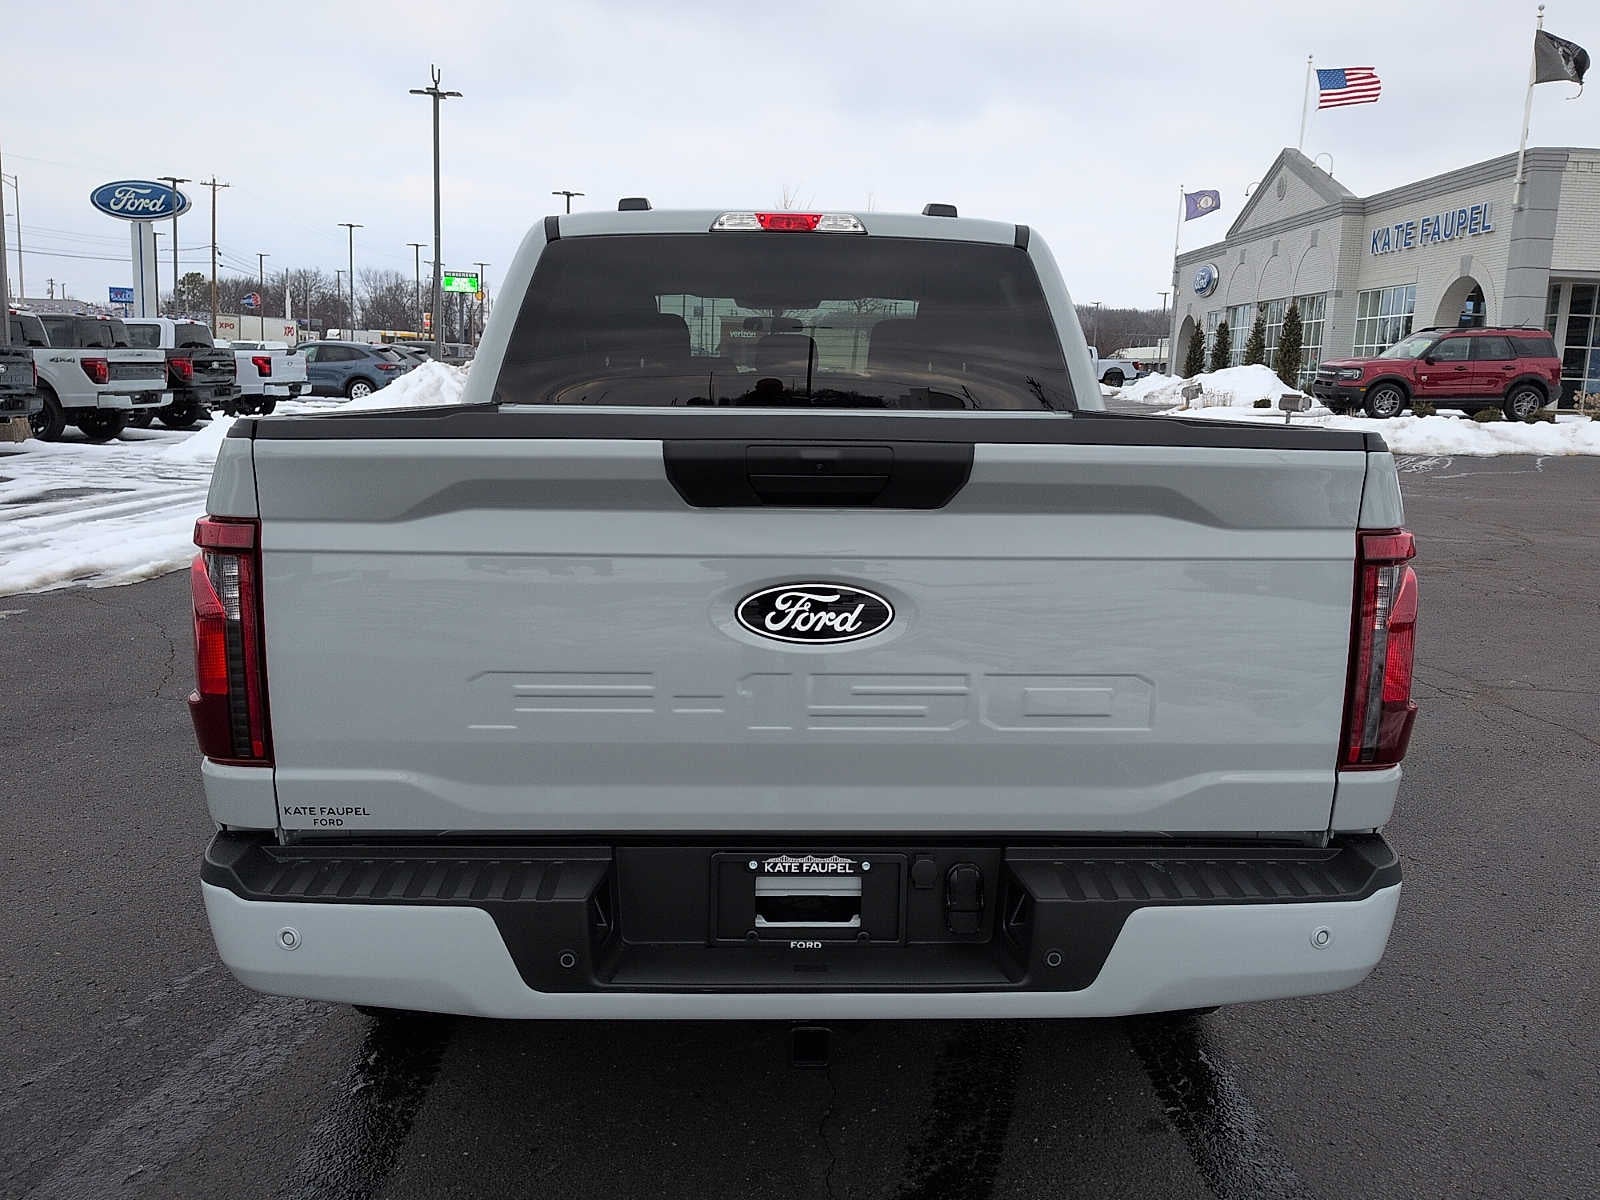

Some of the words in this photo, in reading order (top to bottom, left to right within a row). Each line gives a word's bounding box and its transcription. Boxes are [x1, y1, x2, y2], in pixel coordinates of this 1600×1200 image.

[109, 186, 166, 212] Ford
[1370, 221, 1417, 255] KATE
[1419, 202, 1495, 245] FAUPEL
[219, 322, 234, 330] XPO
[283, 326, 295, 337] XPO
[764, 591, 865, 632] Ford
[466, 671, 1155, 732] F-150
[283, 806, 316, 816] KATE
[319, 807, 371, 816] FAUPEL
[313, 818, 344, 826] FORD
[764, 862, 800, 873] KATE
[802, 862, 855, 873] FAUPEL
[790, 941, 822, 949] FORD
